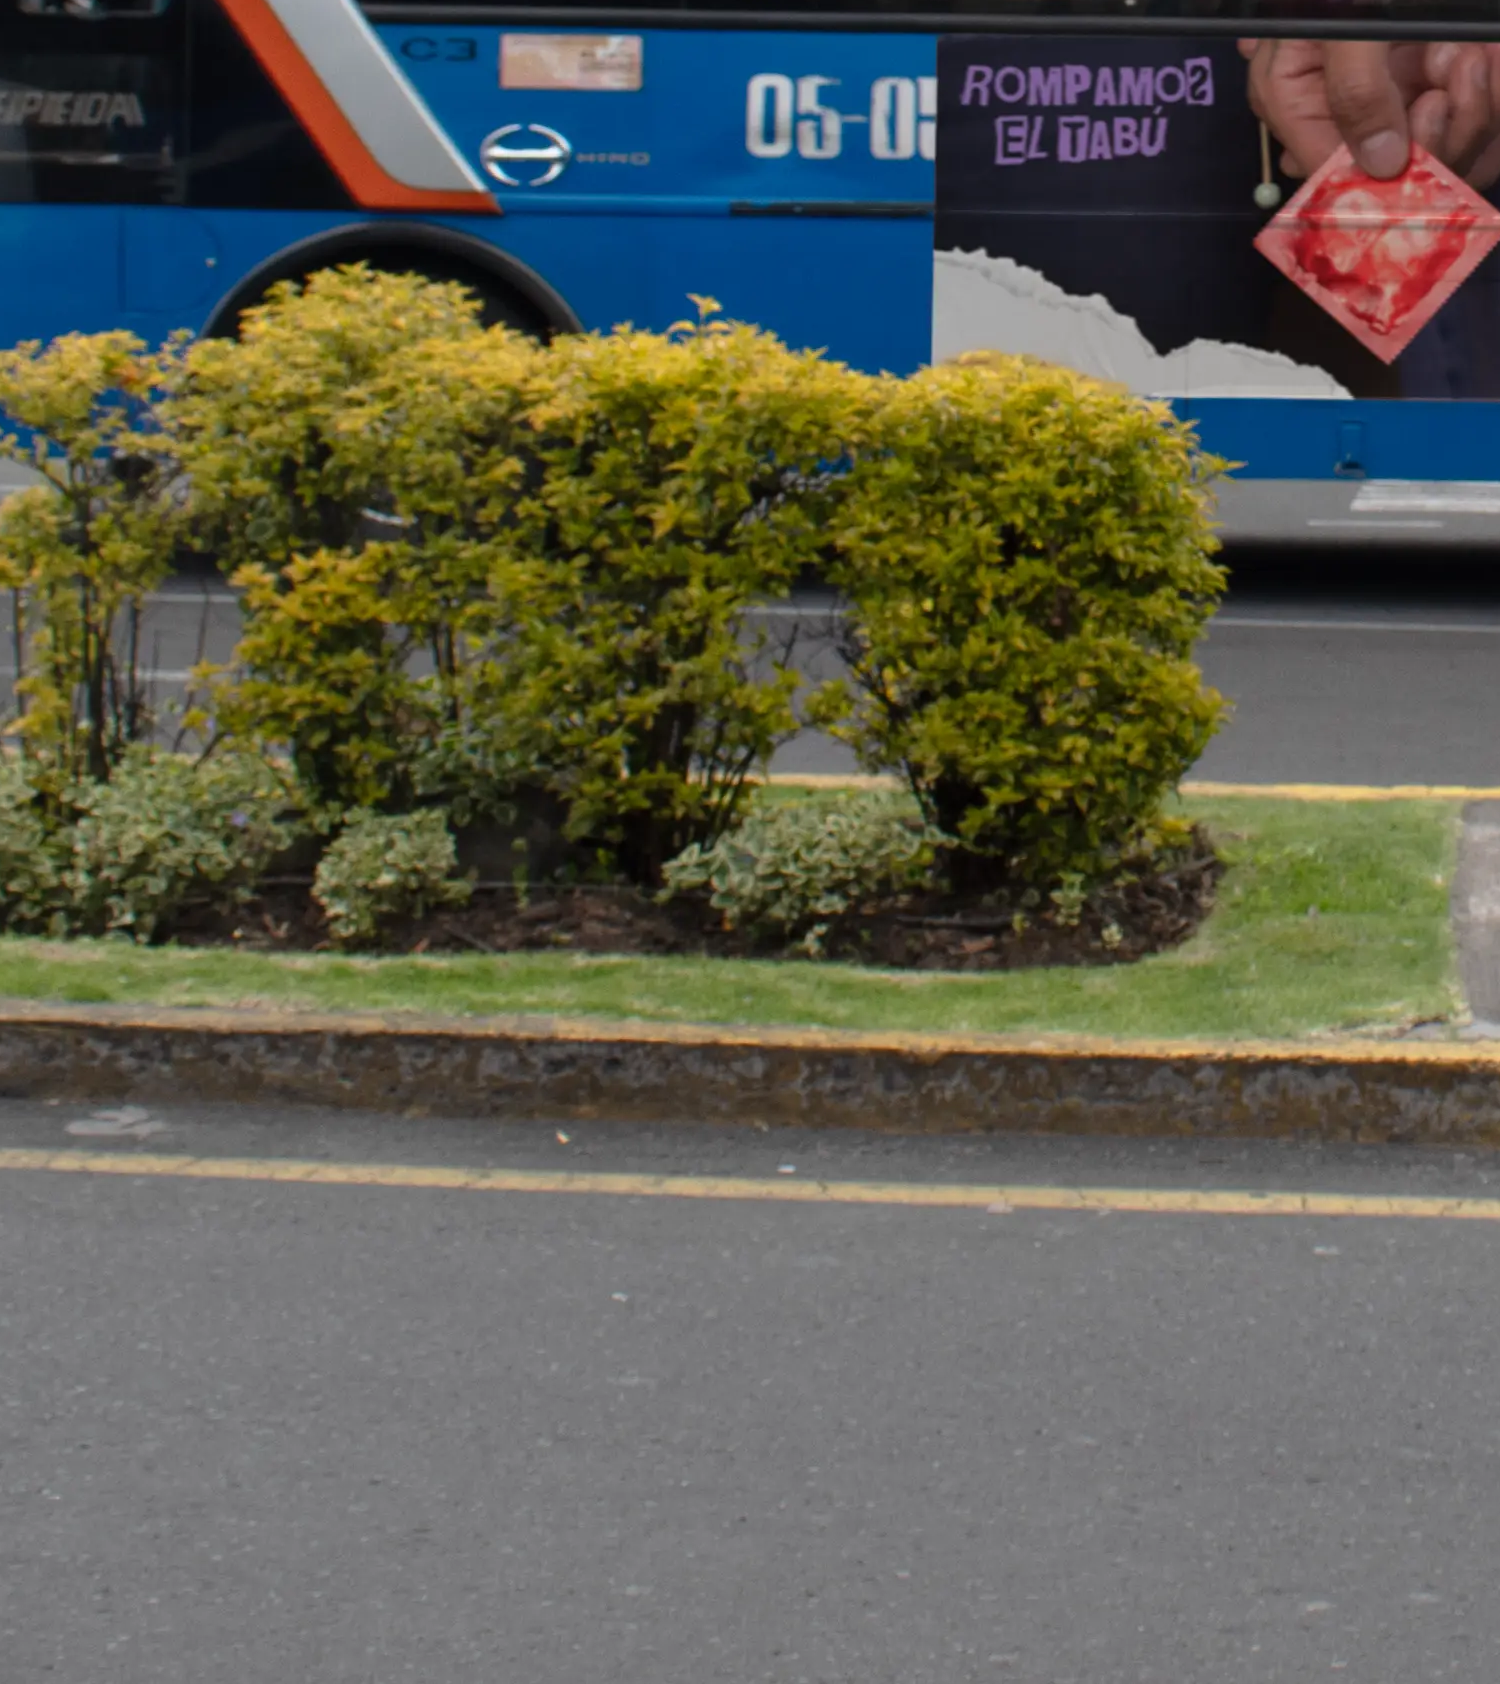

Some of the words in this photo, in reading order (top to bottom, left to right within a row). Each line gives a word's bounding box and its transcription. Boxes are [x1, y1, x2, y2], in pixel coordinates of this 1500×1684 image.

[401, 36, 478, 62] C3
[994, 115, 1049, 165] EL
[1057, 105, 1168, 163] TABÚ
